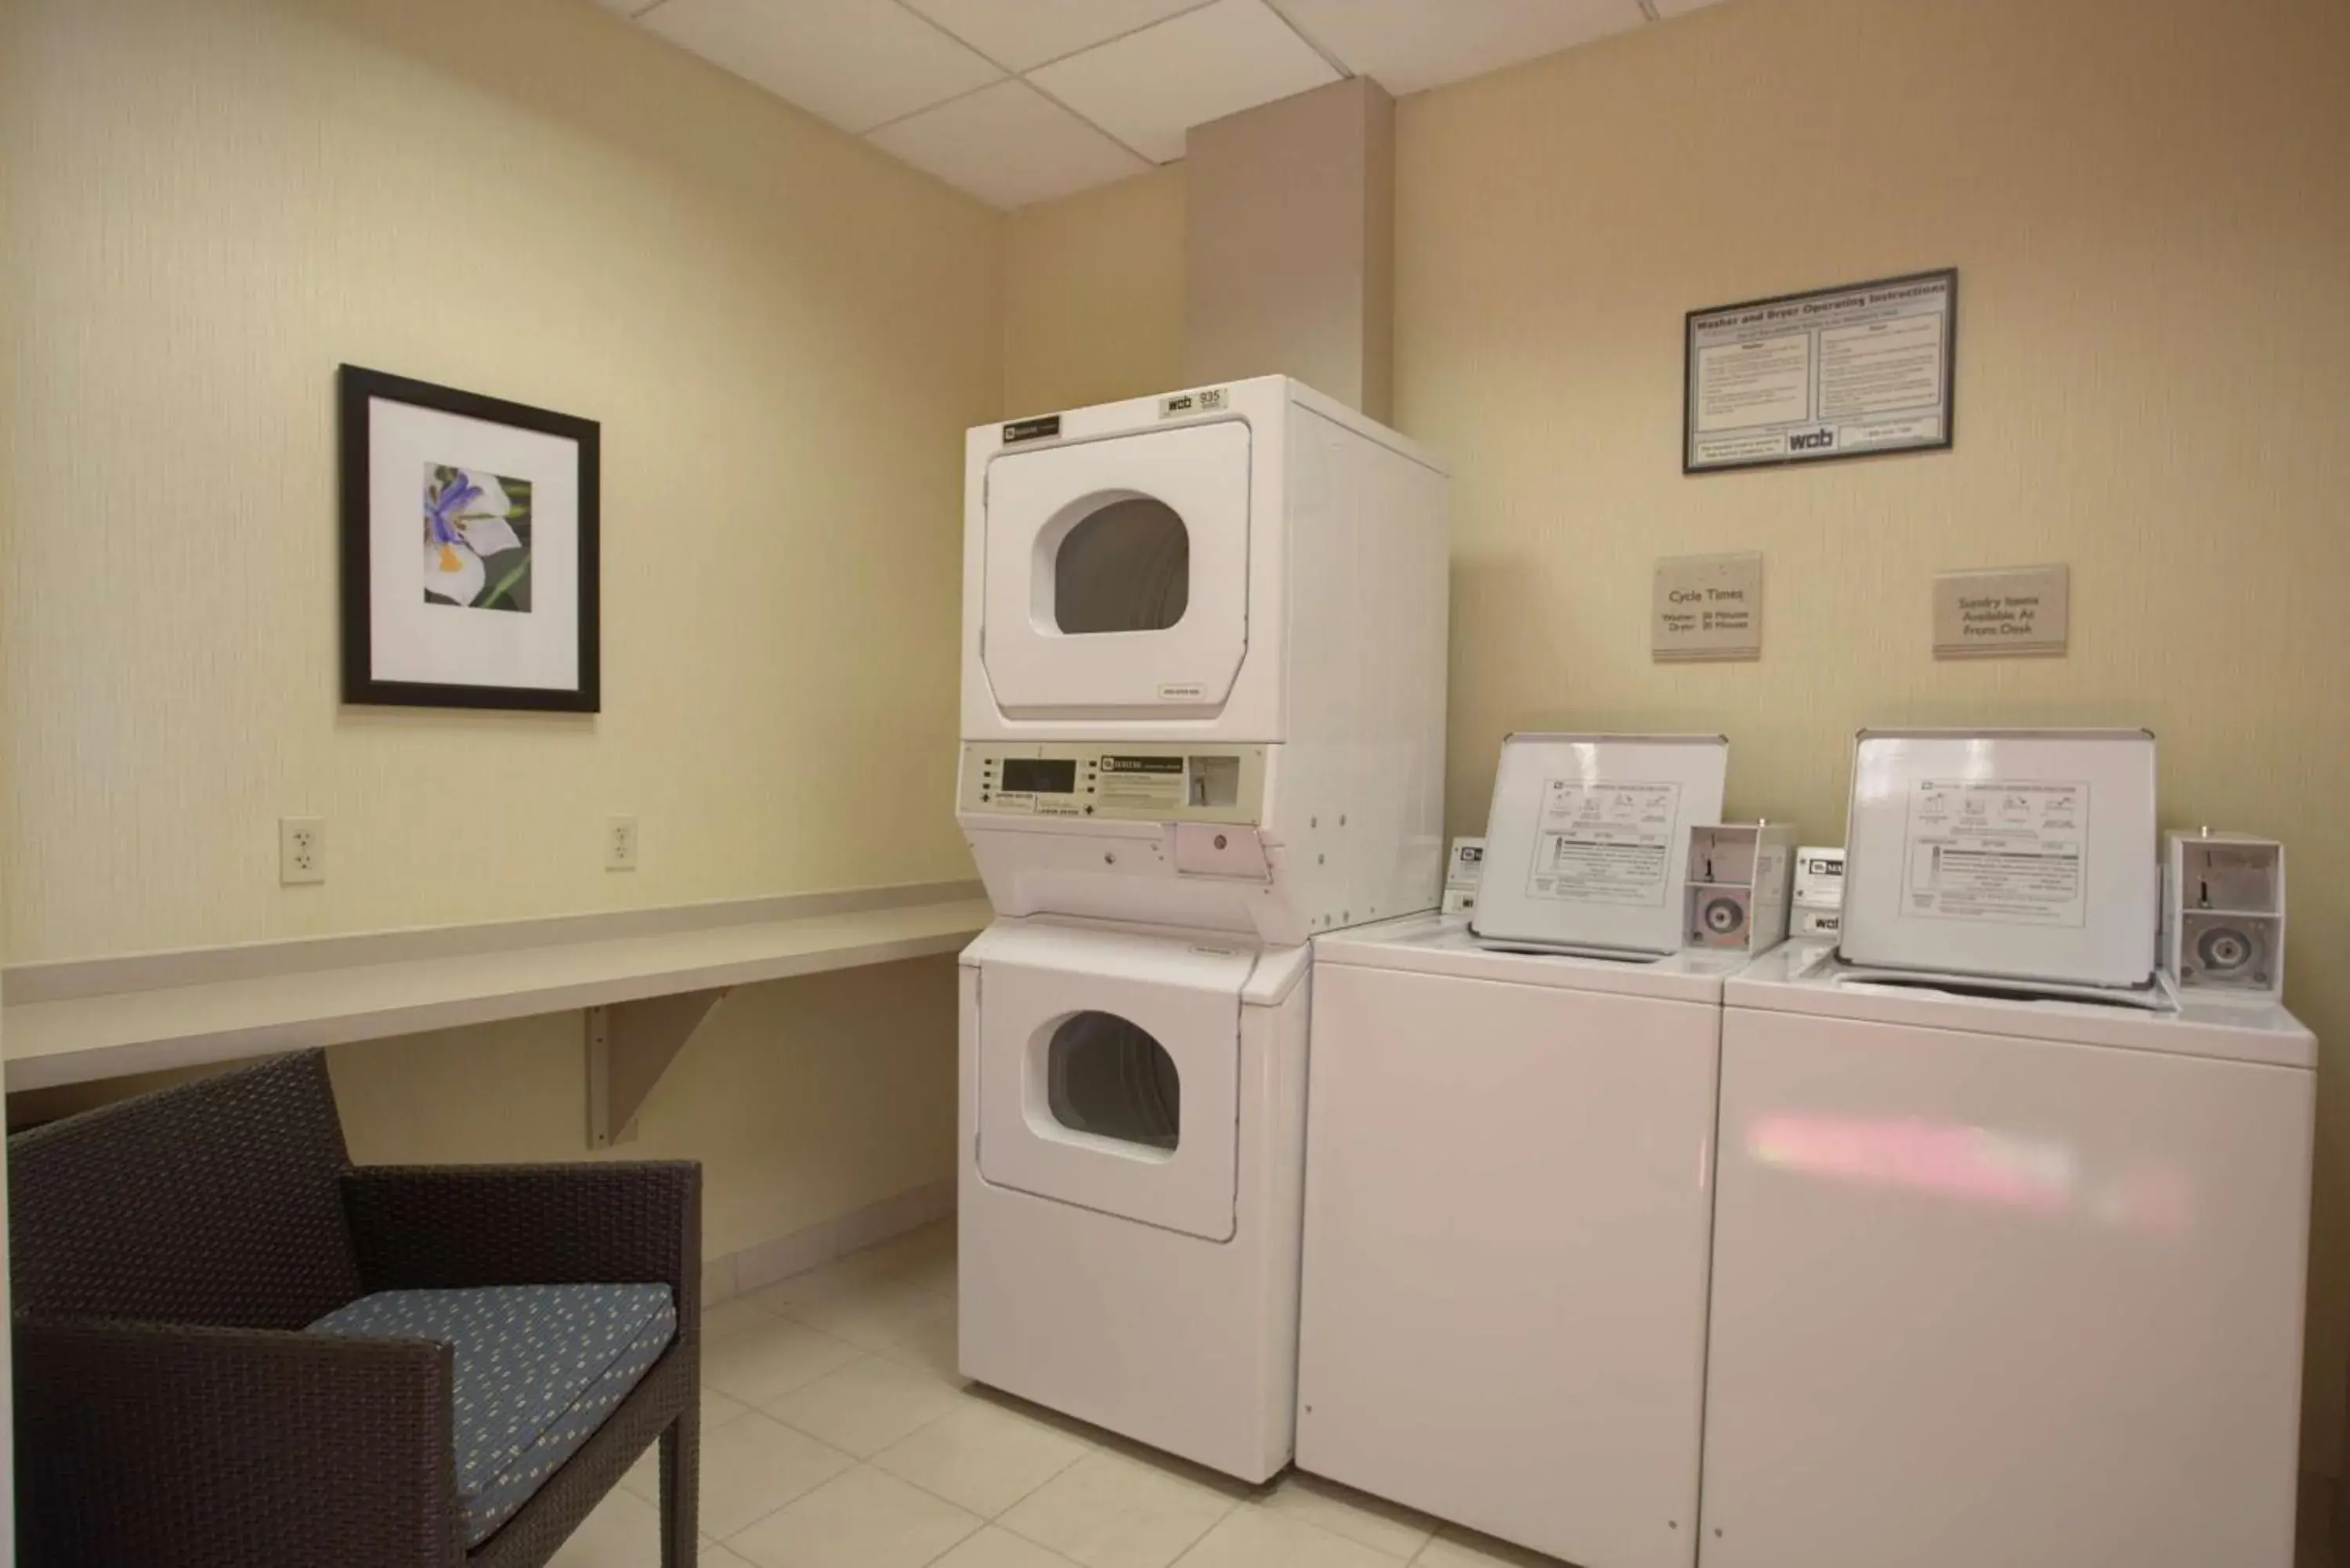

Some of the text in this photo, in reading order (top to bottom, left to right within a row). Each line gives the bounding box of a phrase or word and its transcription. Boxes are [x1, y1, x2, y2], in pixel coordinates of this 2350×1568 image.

[1697, 284, 1946, 330] Washer and Dryer Operating Instructions
[1668, 587, 1744, 605] Cycle Times
